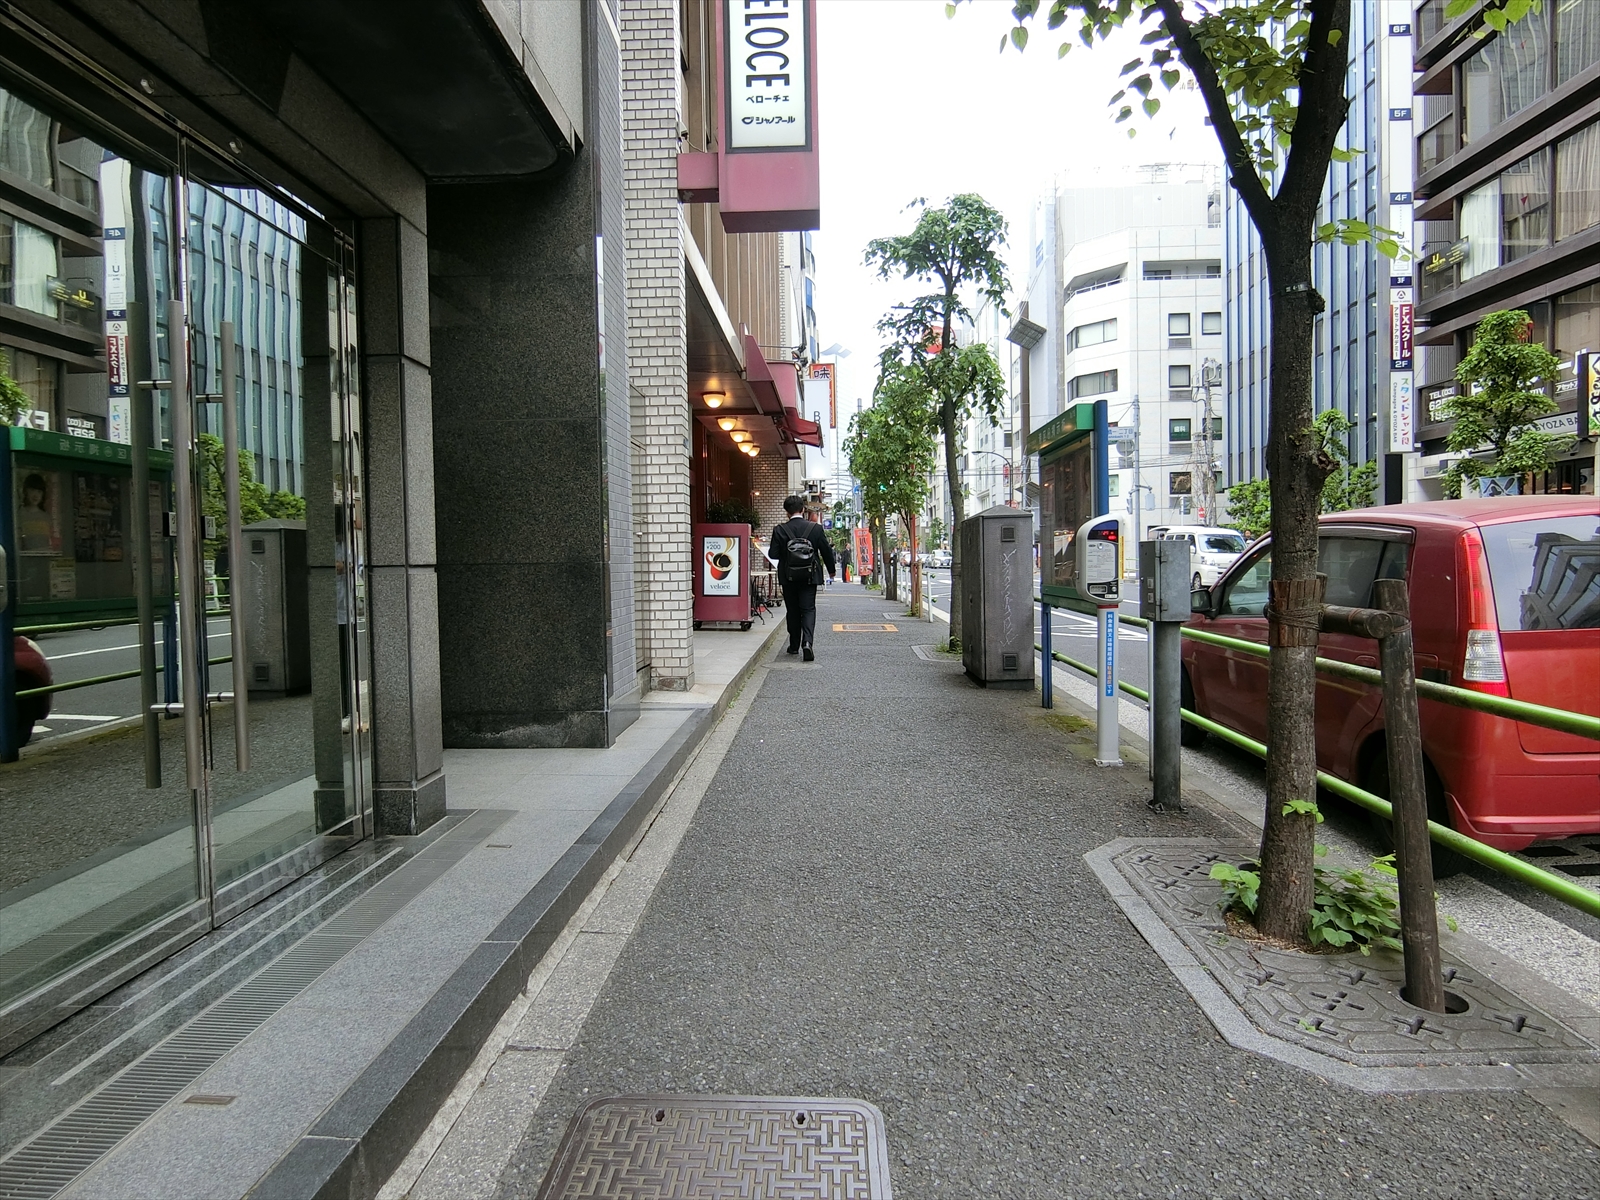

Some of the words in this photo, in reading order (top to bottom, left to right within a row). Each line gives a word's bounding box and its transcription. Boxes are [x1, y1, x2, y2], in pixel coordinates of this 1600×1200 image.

[1393, 25, 1407, 33] 6F
[1393, 110, 1407, 118] 5F
[755, 116, 796, 125] シャノアール
[1401, 306, 1411, 358] FXスクール
[1395, 360, 1408, 368] 2F
[813, 366, 830, 379] 味
